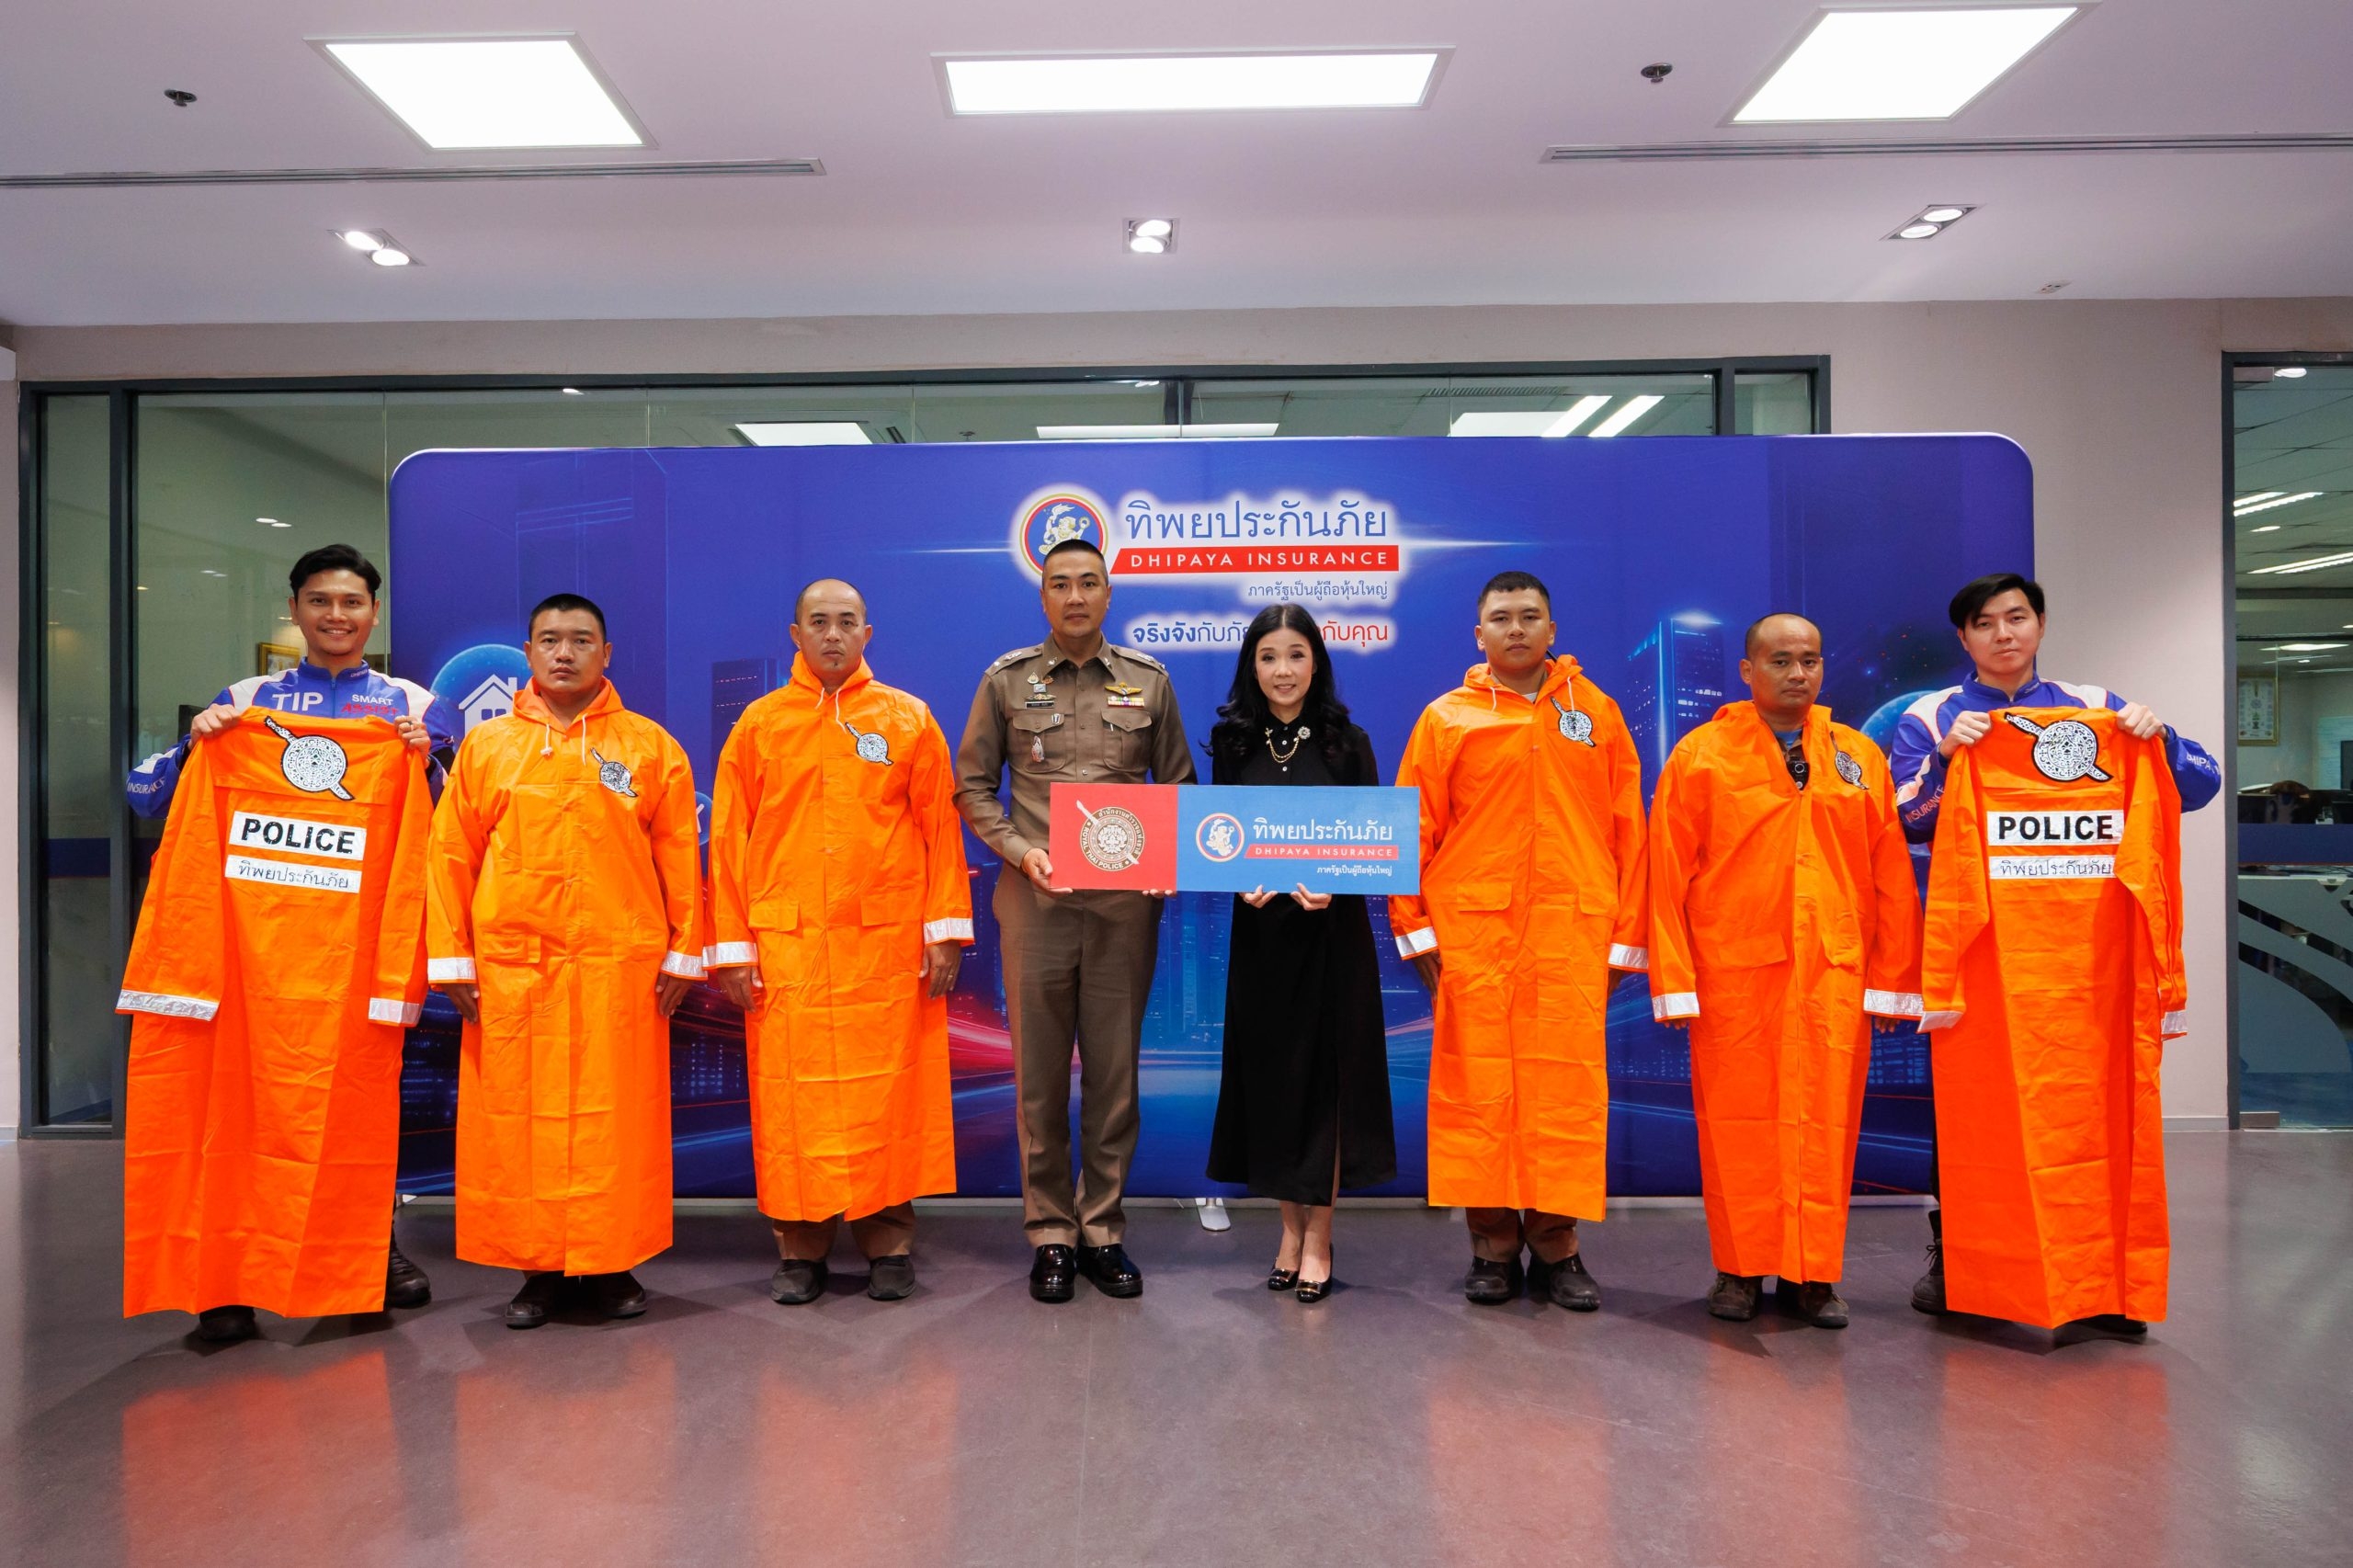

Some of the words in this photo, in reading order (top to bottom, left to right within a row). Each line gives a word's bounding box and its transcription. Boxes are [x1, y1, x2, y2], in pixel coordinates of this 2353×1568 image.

[1125, 499, 1387, 540] ทิพยประกันภัย
[1131, 553, 1233, 568] DHIPAYA
[1247, 551, 1388, 566] INSURANCE
[1248, 580, 1388, 601] ภาครัฐเป็นผู้ถือหุ้นใหญ่
[1319, 619, 1389, 648] กับคุณ
[271, 691, 324, 711] TIP
[340, 702, 399, 716] ASSIST
[351, 694, 393, 706] SMART
[241, 817, 356, 854] POLICE
[1253, 816, 1392, 841] ทิพยประกันภัย
[1998, 815, 2113, 841] POLICE
[1082, 826, 1090, 850] ROYAL
[1086, 849, 1098, 864] THAI
[1097, 861, 1124, 870] POLICE
[1255, 846, 1310, 856] DHIPAYA
[1317, 846, 1393, 857] INSURANCE
[237, 859, 349, 889] ทิพยประกันภัย
[2000, 859, 2111, 876] ทิพยประกันภัย
